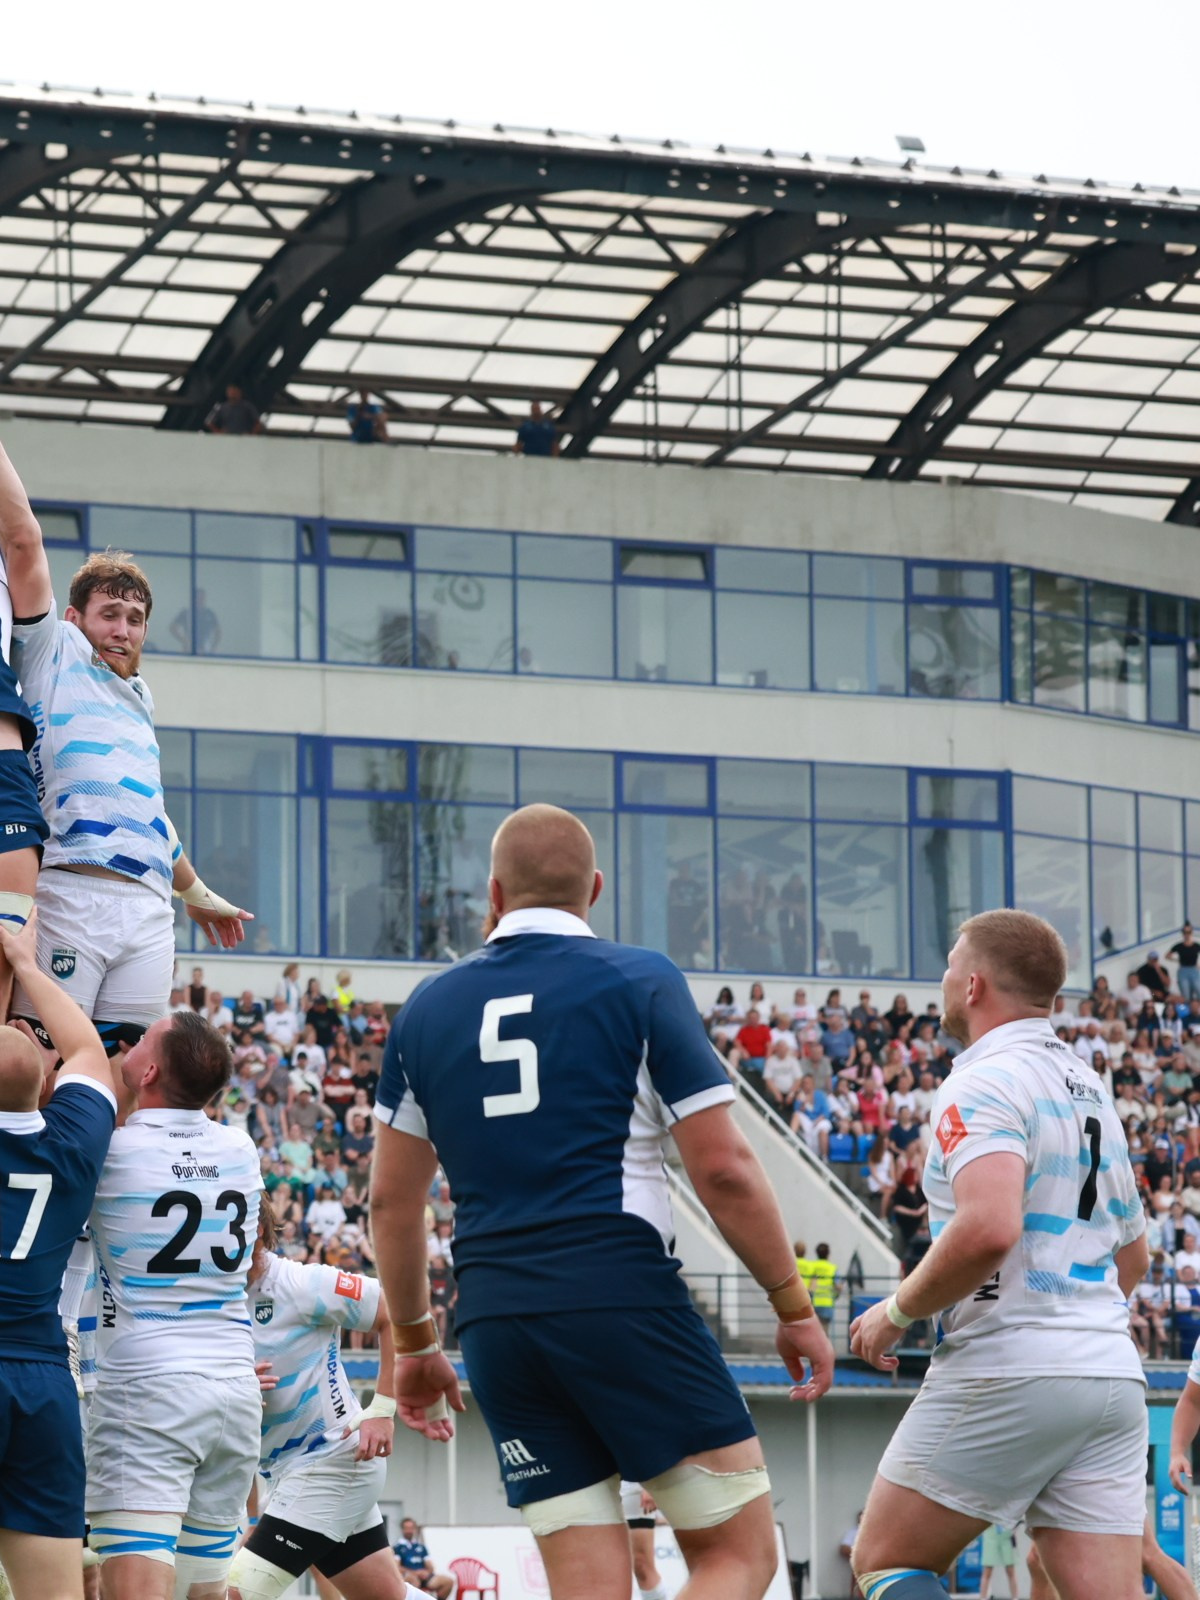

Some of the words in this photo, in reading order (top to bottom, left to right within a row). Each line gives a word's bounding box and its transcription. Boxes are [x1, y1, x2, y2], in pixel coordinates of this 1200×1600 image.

[479, 993, 540, 1118] 5
[1077, 1115, 1102, 1222] 1
[147, 1189, 248, 1274] 23
